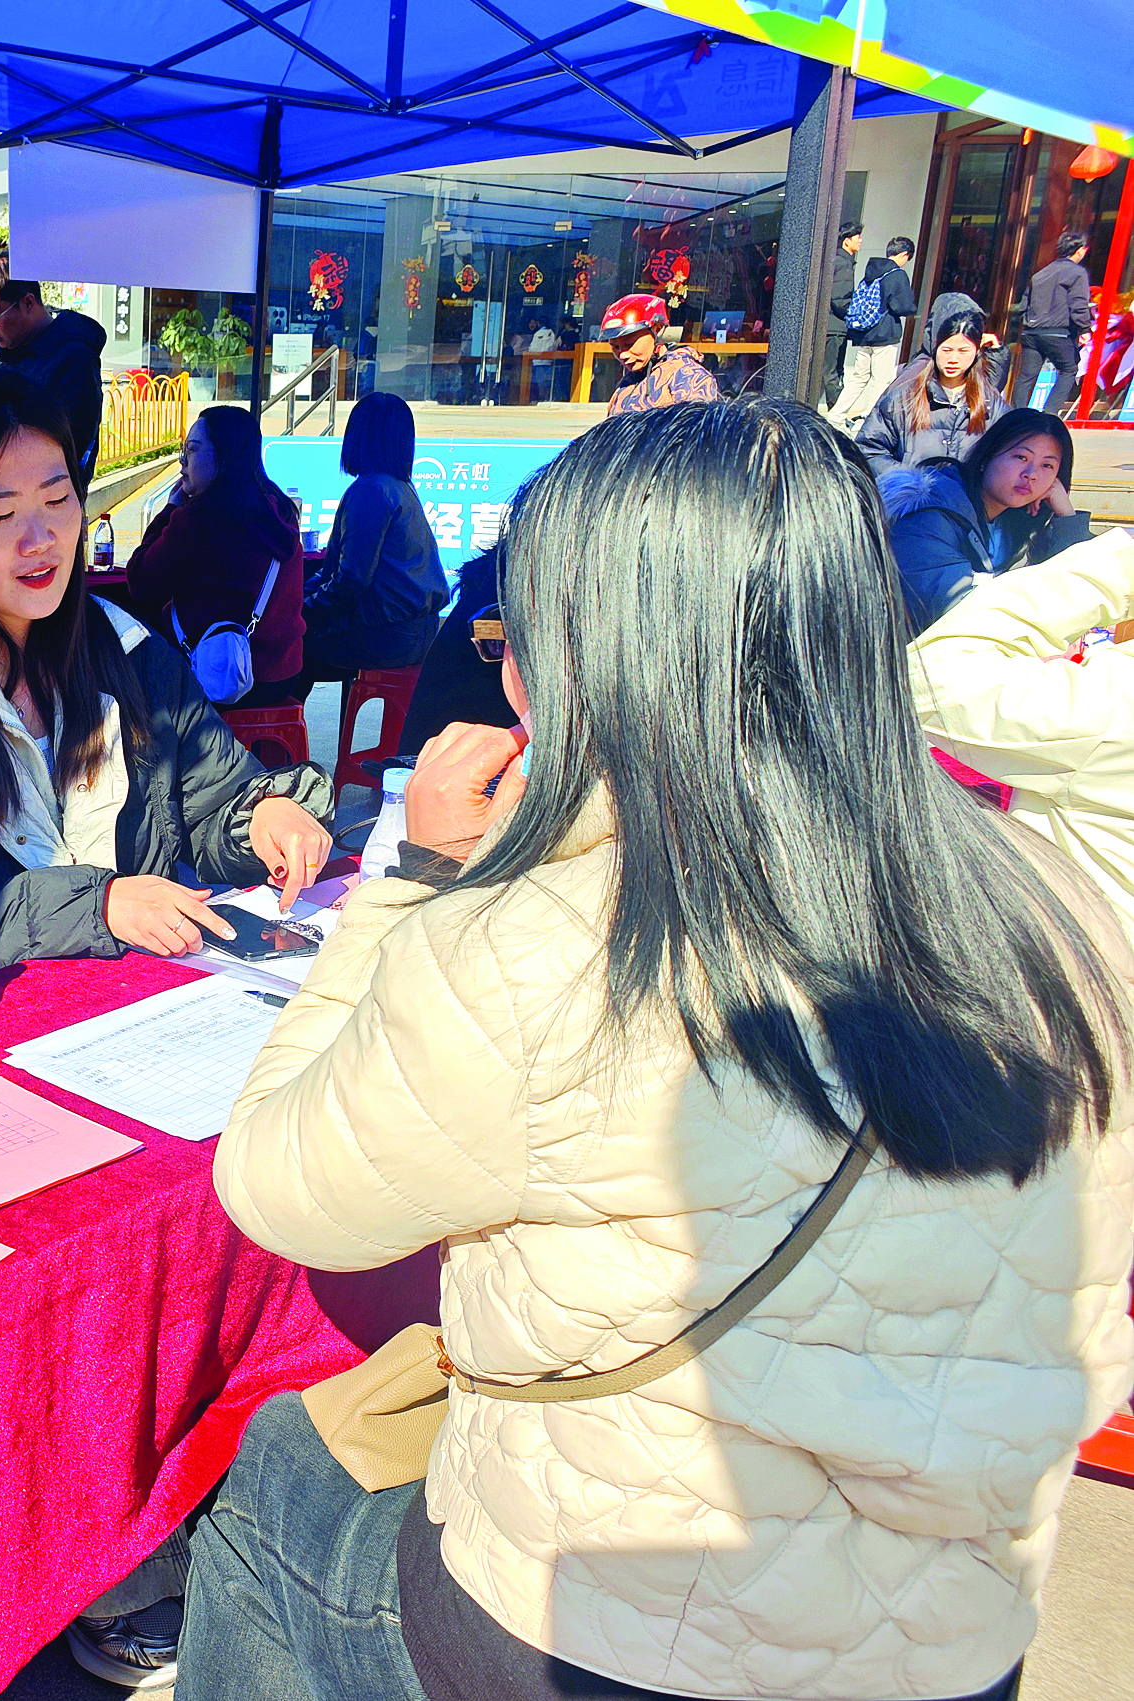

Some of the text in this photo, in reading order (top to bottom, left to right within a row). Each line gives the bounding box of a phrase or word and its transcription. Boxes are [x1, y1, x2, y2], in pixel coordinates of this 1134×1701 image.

[116, 286, 130, 335] 务中心
[452, 462, 492, 481] 天虹
